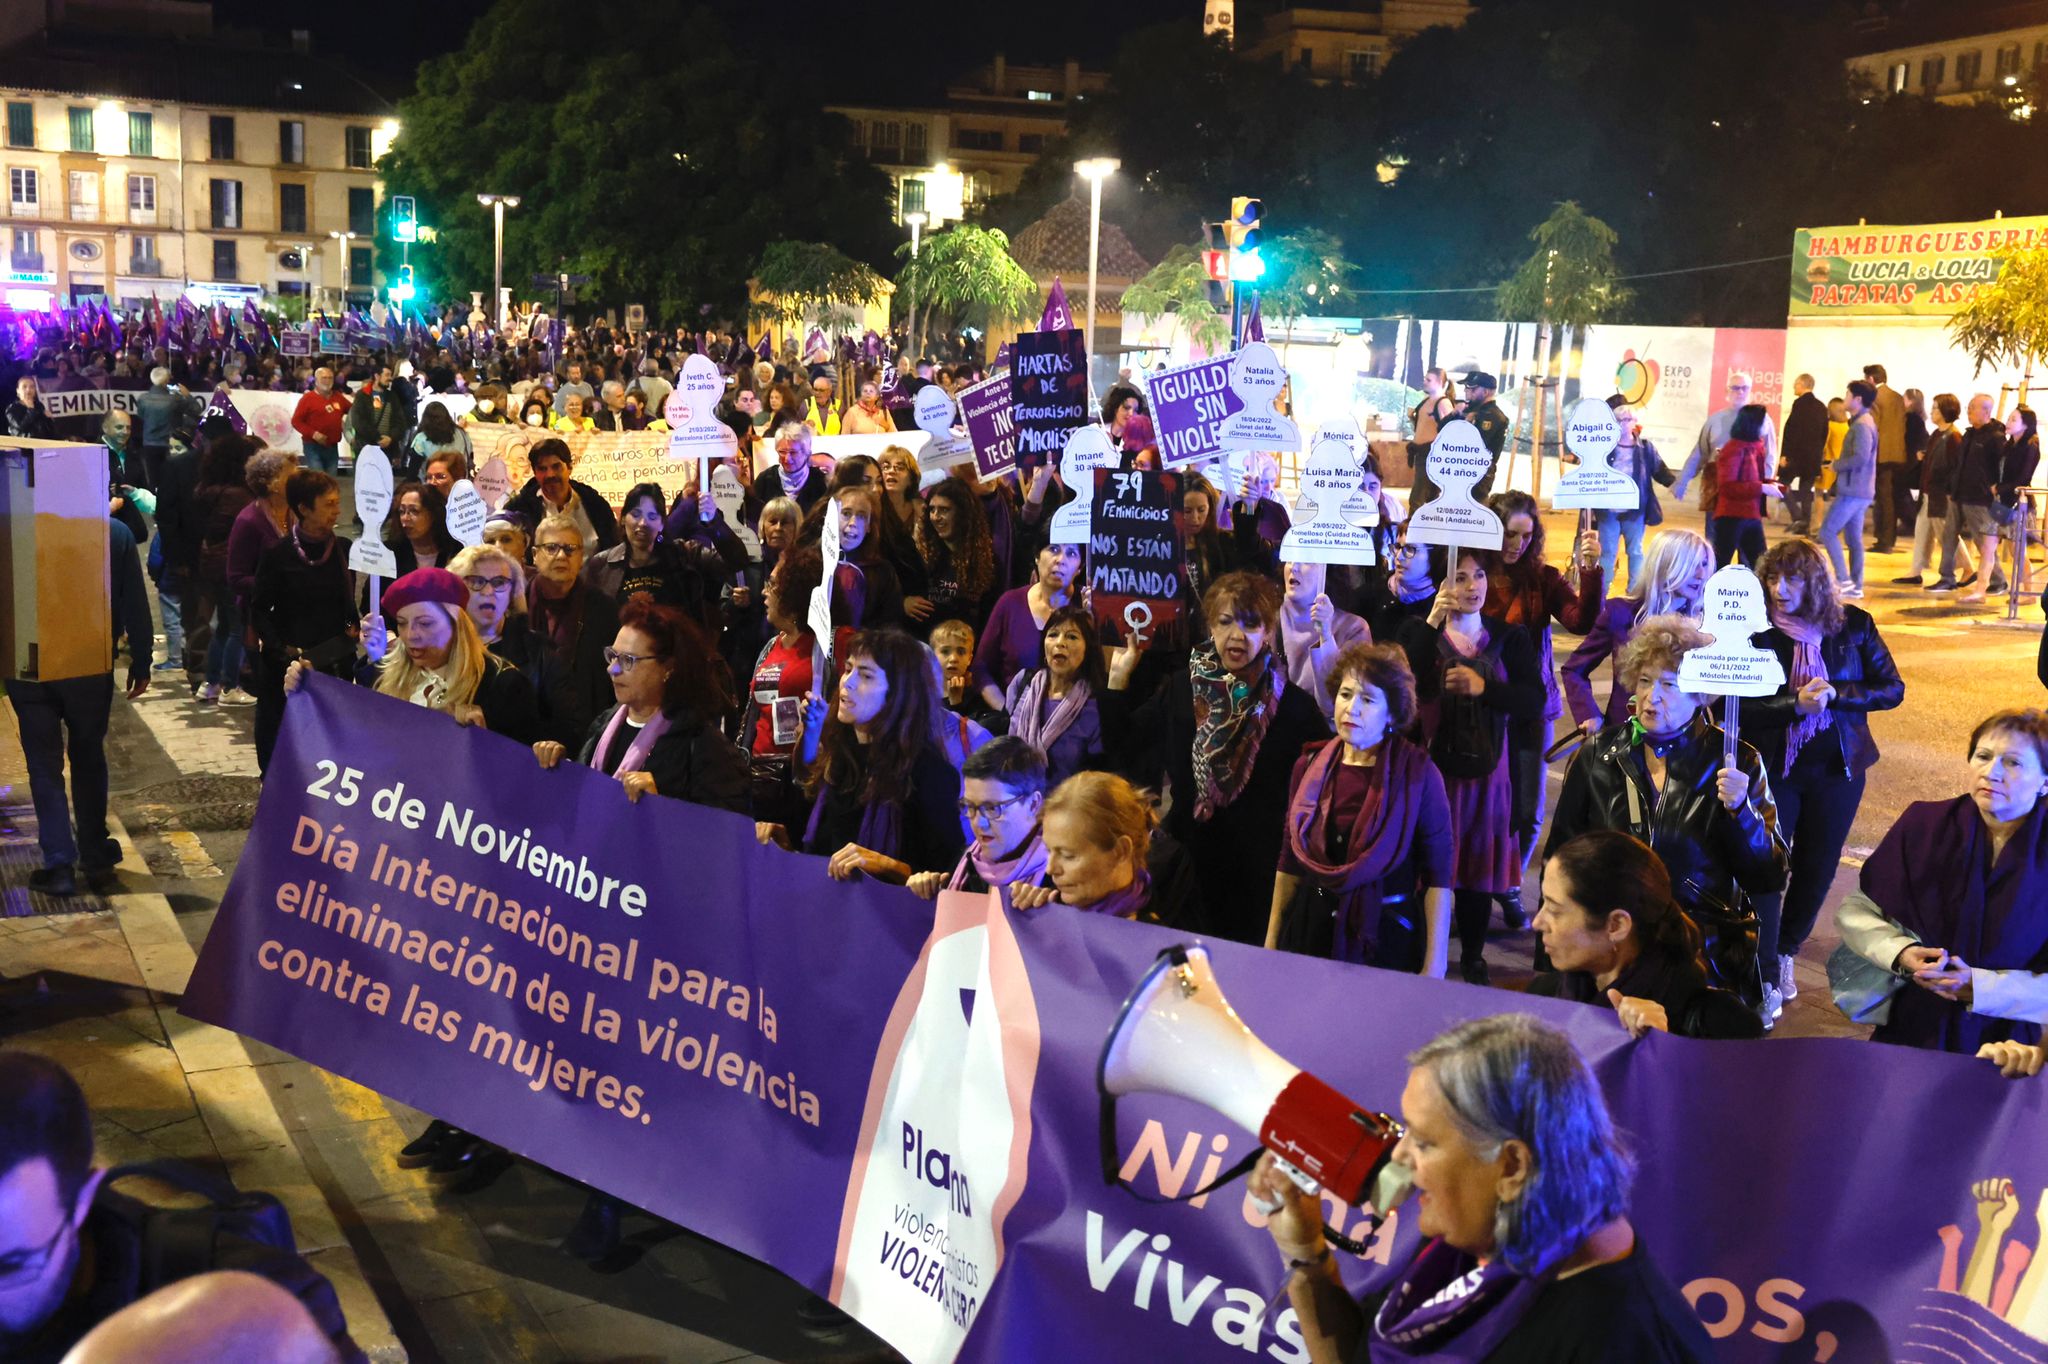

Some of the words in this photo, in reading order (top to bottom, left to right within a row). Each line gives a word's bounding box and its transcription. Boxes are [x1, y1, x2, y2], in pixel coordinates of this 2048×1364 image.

[1851, 261, 1910, 280] LUCIA
[1917, 266, 1927, 278] &
[1811, 283, 1915, 305] PATATAS
[1929, 283, 1979, 304] ASA
[1018, 353, 1073, 376] HARTAS
[1245, 366, 1274, 376] Natalia
[1664, 365, 1692, 378] EXPO
[1040, 377, 1058, 394] DE
[1154, 362, 1232, 405] IGUALD
[1243, 377, 1253, 385] 53
[1255, 377, 1276, 386] años
[1664, 379, 1691, 389] 2027
[984, 387, 1001, 398] Ante
[1001, 381, 1008, 391] la
[967, 400, 999, 418] Violencia
[999, 395, 1008, 405] de
[1194, 392, 1228, 422] SIN
[932, 411, 948, 420] años
[1572, 424, 1603, 433] Abigail
[1018, 427, 1079, 453] MACHIST
[1165, 420, 1221, 457] VIOLE
[1323, 431, 1354, 440] Mónica
[1590, 434, 1611, 442] años
[1442, 443, 1480, 453] Nombre
[984, 444, 1001, 466] TE
[1075, 452, 1104, 461] Imane
[1445, 457, 1490, 466] conocido
[612, 466, 627, 480] de
[1074, 464, 1085, 472] 30
[1306, 467, 1332, 476] Luisa
[1440, 467, 1451, 475] 44
[1454, 468, 1477, 477] años
[1112, 470, 1143, 502] 79
[1314, 480, 1325, 488] 48
[1328, 480, 1351, 489] años
[454, 491, 473, 502] Nombre
[458, 498, 485, 511] conocido
[465, 509, 477, 517] años
[1421, 514, 1444, 522] Sevilla
[1291, 529, 1323, 537] Tomelloso
[1091, 533, 1118, 556] NOS
[1127, 533, 1172, 560] ESTÁN
[1091, 563, 1178, 598] MATANDO
[1718, 588, 1749, 598] Mariya
[1723, 601, 1742, 609] P.D.
[1725, 612, 1747, 621] años
[1691, 653, 1726, 661] Asesinada
[1727, 655, 1739, 663] por
[1750, 656, 1771, 664] padre
[1709, 663, 1751, 671] 06/11/2022
[1699, 672, 1731, 680] Móstoles
[1732, 673, 1763, 681] (Madrid)
[306, 759, 364, 809] 25
[371, 781, 426, 830] de
[435, 801, 648, 918] Noviembre
[291, 815, 359, 874] Día
[370, 843, 639, 983] Internacional
[648, 957, 750, 1023] para
[759, 986, 777, 1043] la
[276, 877, 517, 1000] eliminación
[526, 971, 570, 1023] de
[581, 992, 619, 1044] la
[638, 1017, 820, 1128] violencia
[257, 938, 391, 1016] contra
[400, 984, 459, 1043] las
[469, 1022, 650, 1125] mujeres.
[1118, 1119, 1229, 1209] Ni
[1086, 1210, 1312, 1364] Vivas
